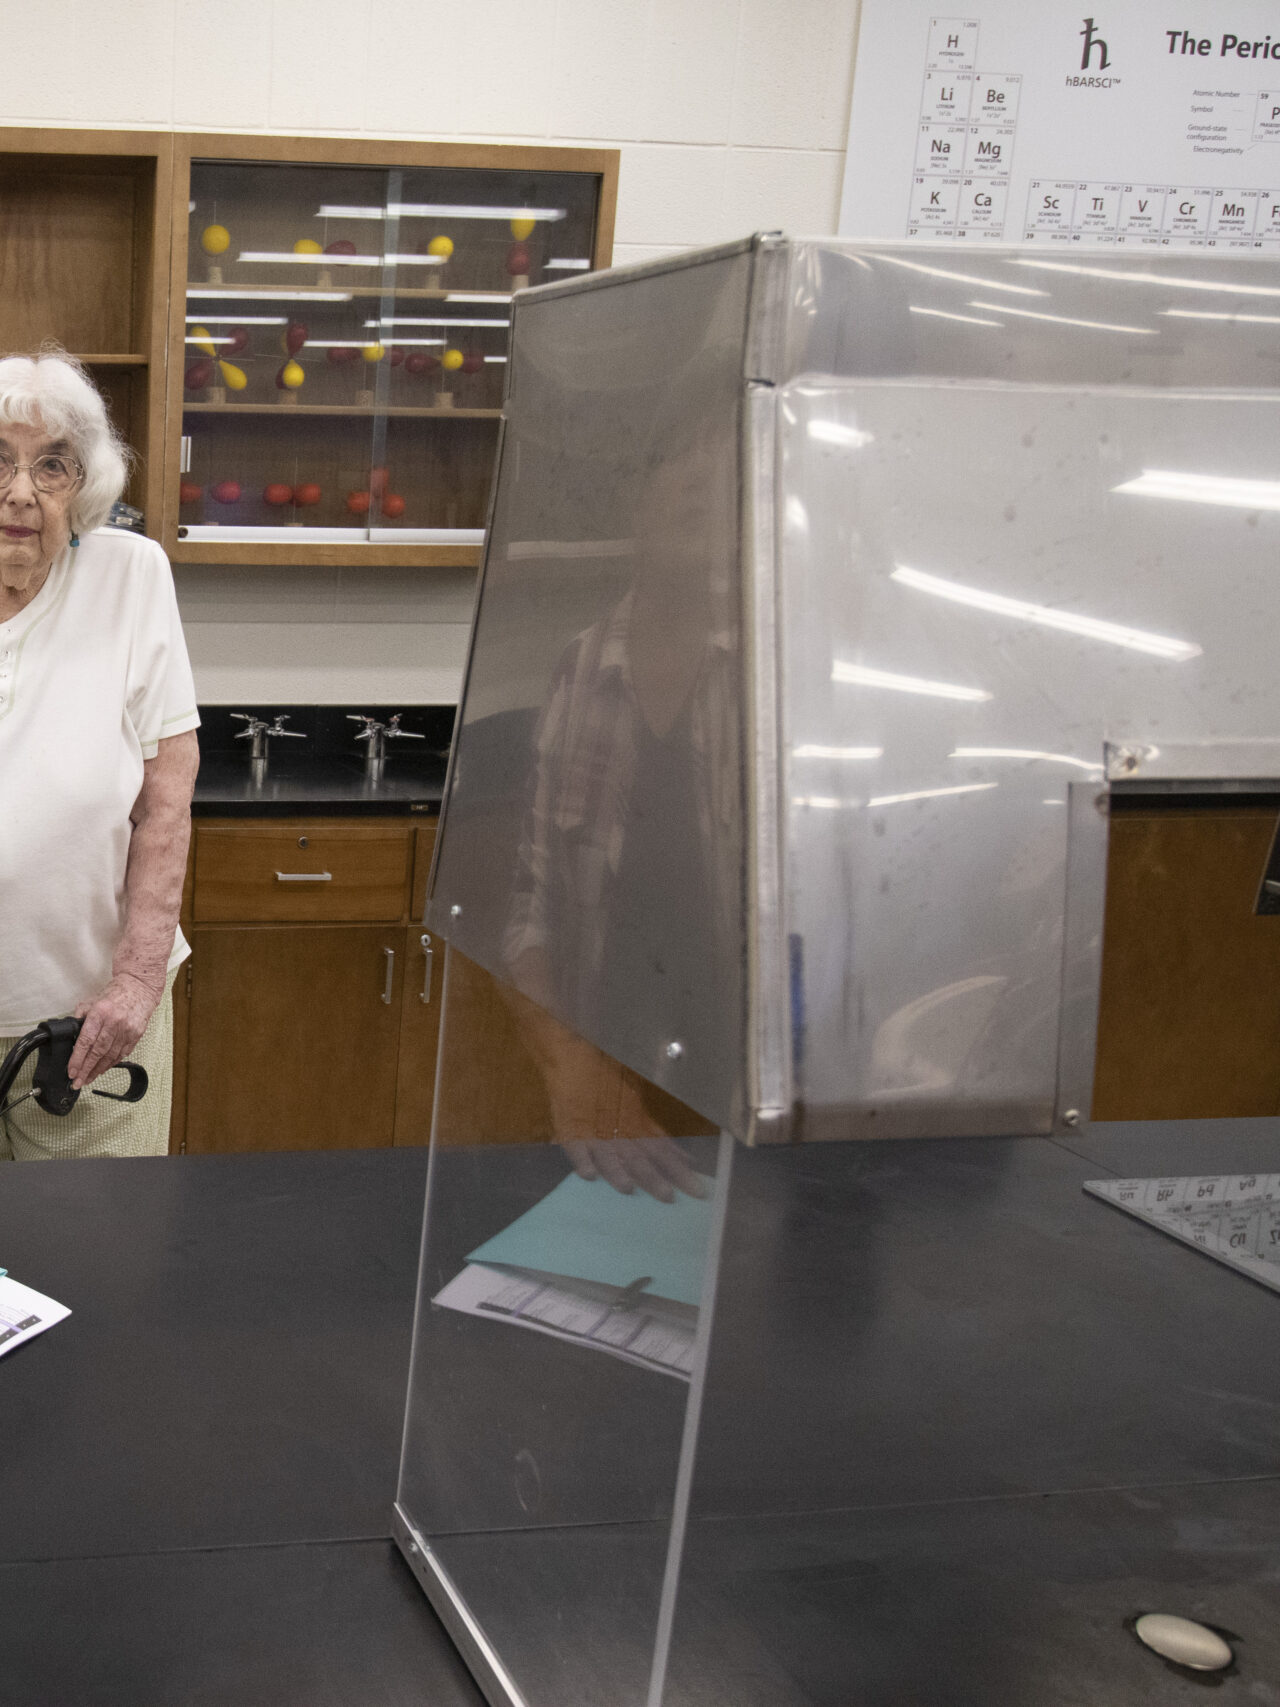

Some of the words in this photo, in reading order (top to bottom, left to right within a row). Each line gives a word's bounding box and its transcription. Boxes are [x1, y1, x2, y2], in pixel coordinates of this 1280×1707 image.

[947, 34, 959, 48] H
[1166, 30, 1211, 56] The
[941, 87, 954, 101] Li
[987, 89, 1005, 103] Be
[1190, 105, 1213, 113] Symbol
[931, 140, 951, 153] Na
[978, 141, 1001, 158] Mg
[930, 192, 941, 205] K
[974, 193, 992, 206] Ca
[1043, 195, 1059, 209] Sc
[1092, 197, 1104, 211] Ti
[1138, 200, 1148, 213] V
[1179, 202, 1195, 215] Cr
[1222, 203, 1245, 217] Mn
[1271, 205, 1280, 218] F
